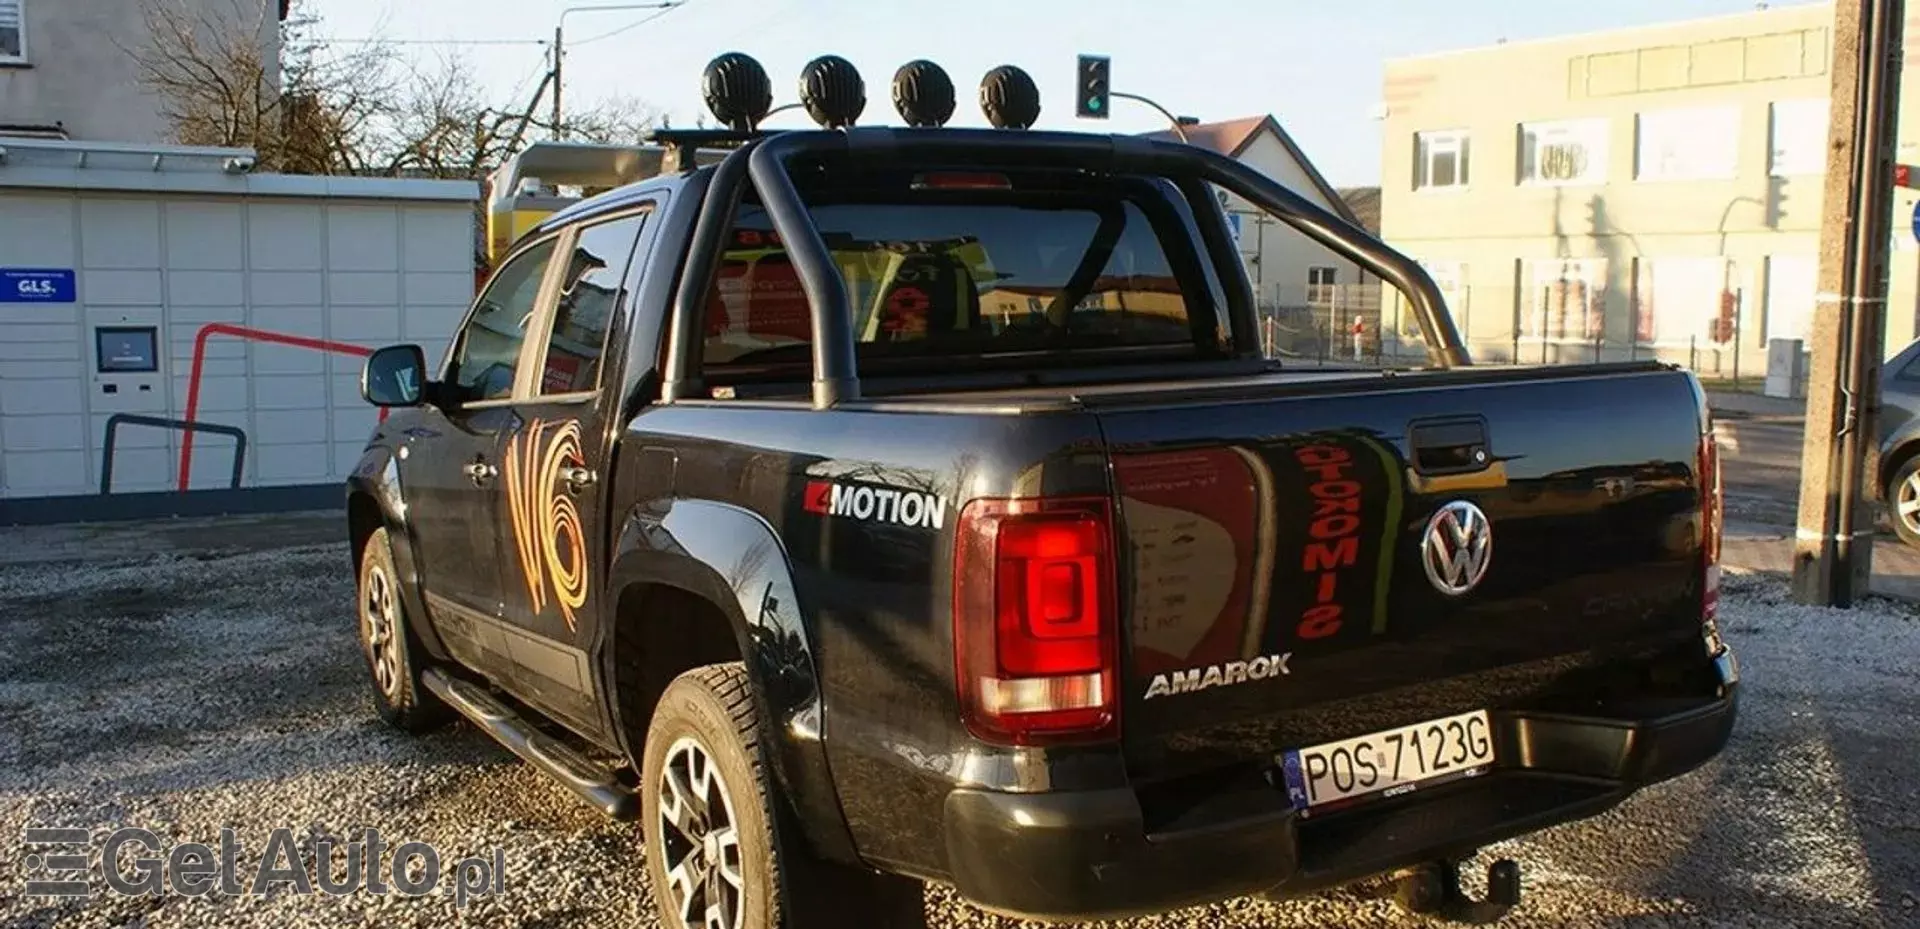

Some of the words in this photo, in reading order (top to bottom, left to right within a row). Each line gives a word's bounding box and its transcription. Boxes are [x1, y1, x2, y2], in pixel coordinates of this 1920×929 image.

[506, 417, 587, 633] V6
[803, 480, 947, 529] 4MOTION
[1143, 652, 1292, 700] AMAROK
[1304, 741, 1378, 800] POS
[1385, 716, 1489, 781] 7123G
